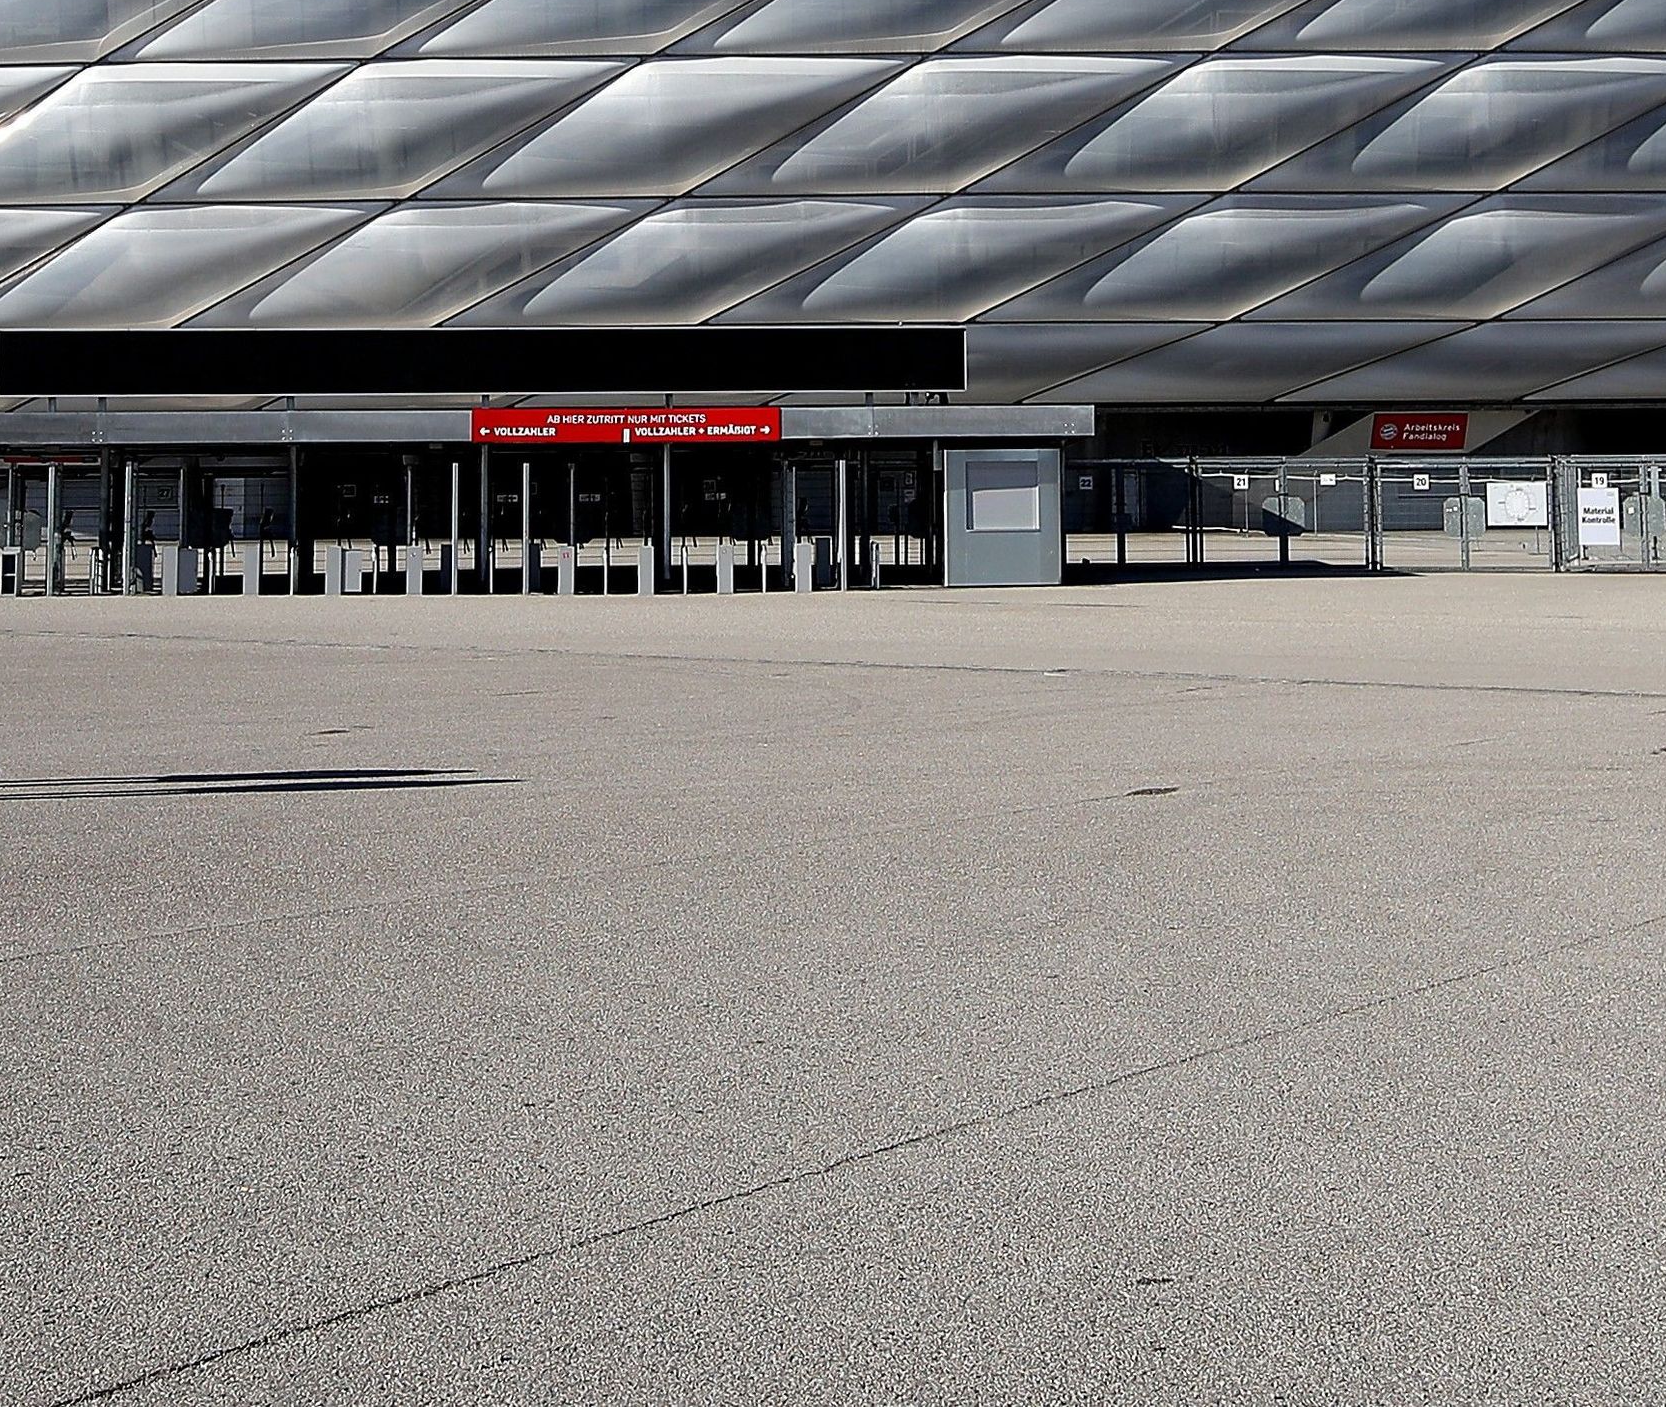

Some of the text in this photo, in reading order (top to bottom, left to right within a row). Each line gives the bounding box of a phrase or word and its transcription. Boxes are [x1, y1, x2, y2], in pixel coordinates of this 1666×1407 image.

[547, 414, 706, 424] AB HIER ZUTRITT NUR MIT TICKETS
[493, 427, 556, 436] VOLLZAHLER
[635, 426, 696, 436] VOLLZAHLER
[1403, 423, 1460, 432] Arbeitskreis
[1402, 432, 1447, 442] Fandialog
[1236, 477, 1247, 487] 21
[1415, 477, 1427, 487] 20
[1595, 476, 1605, 486] 19
